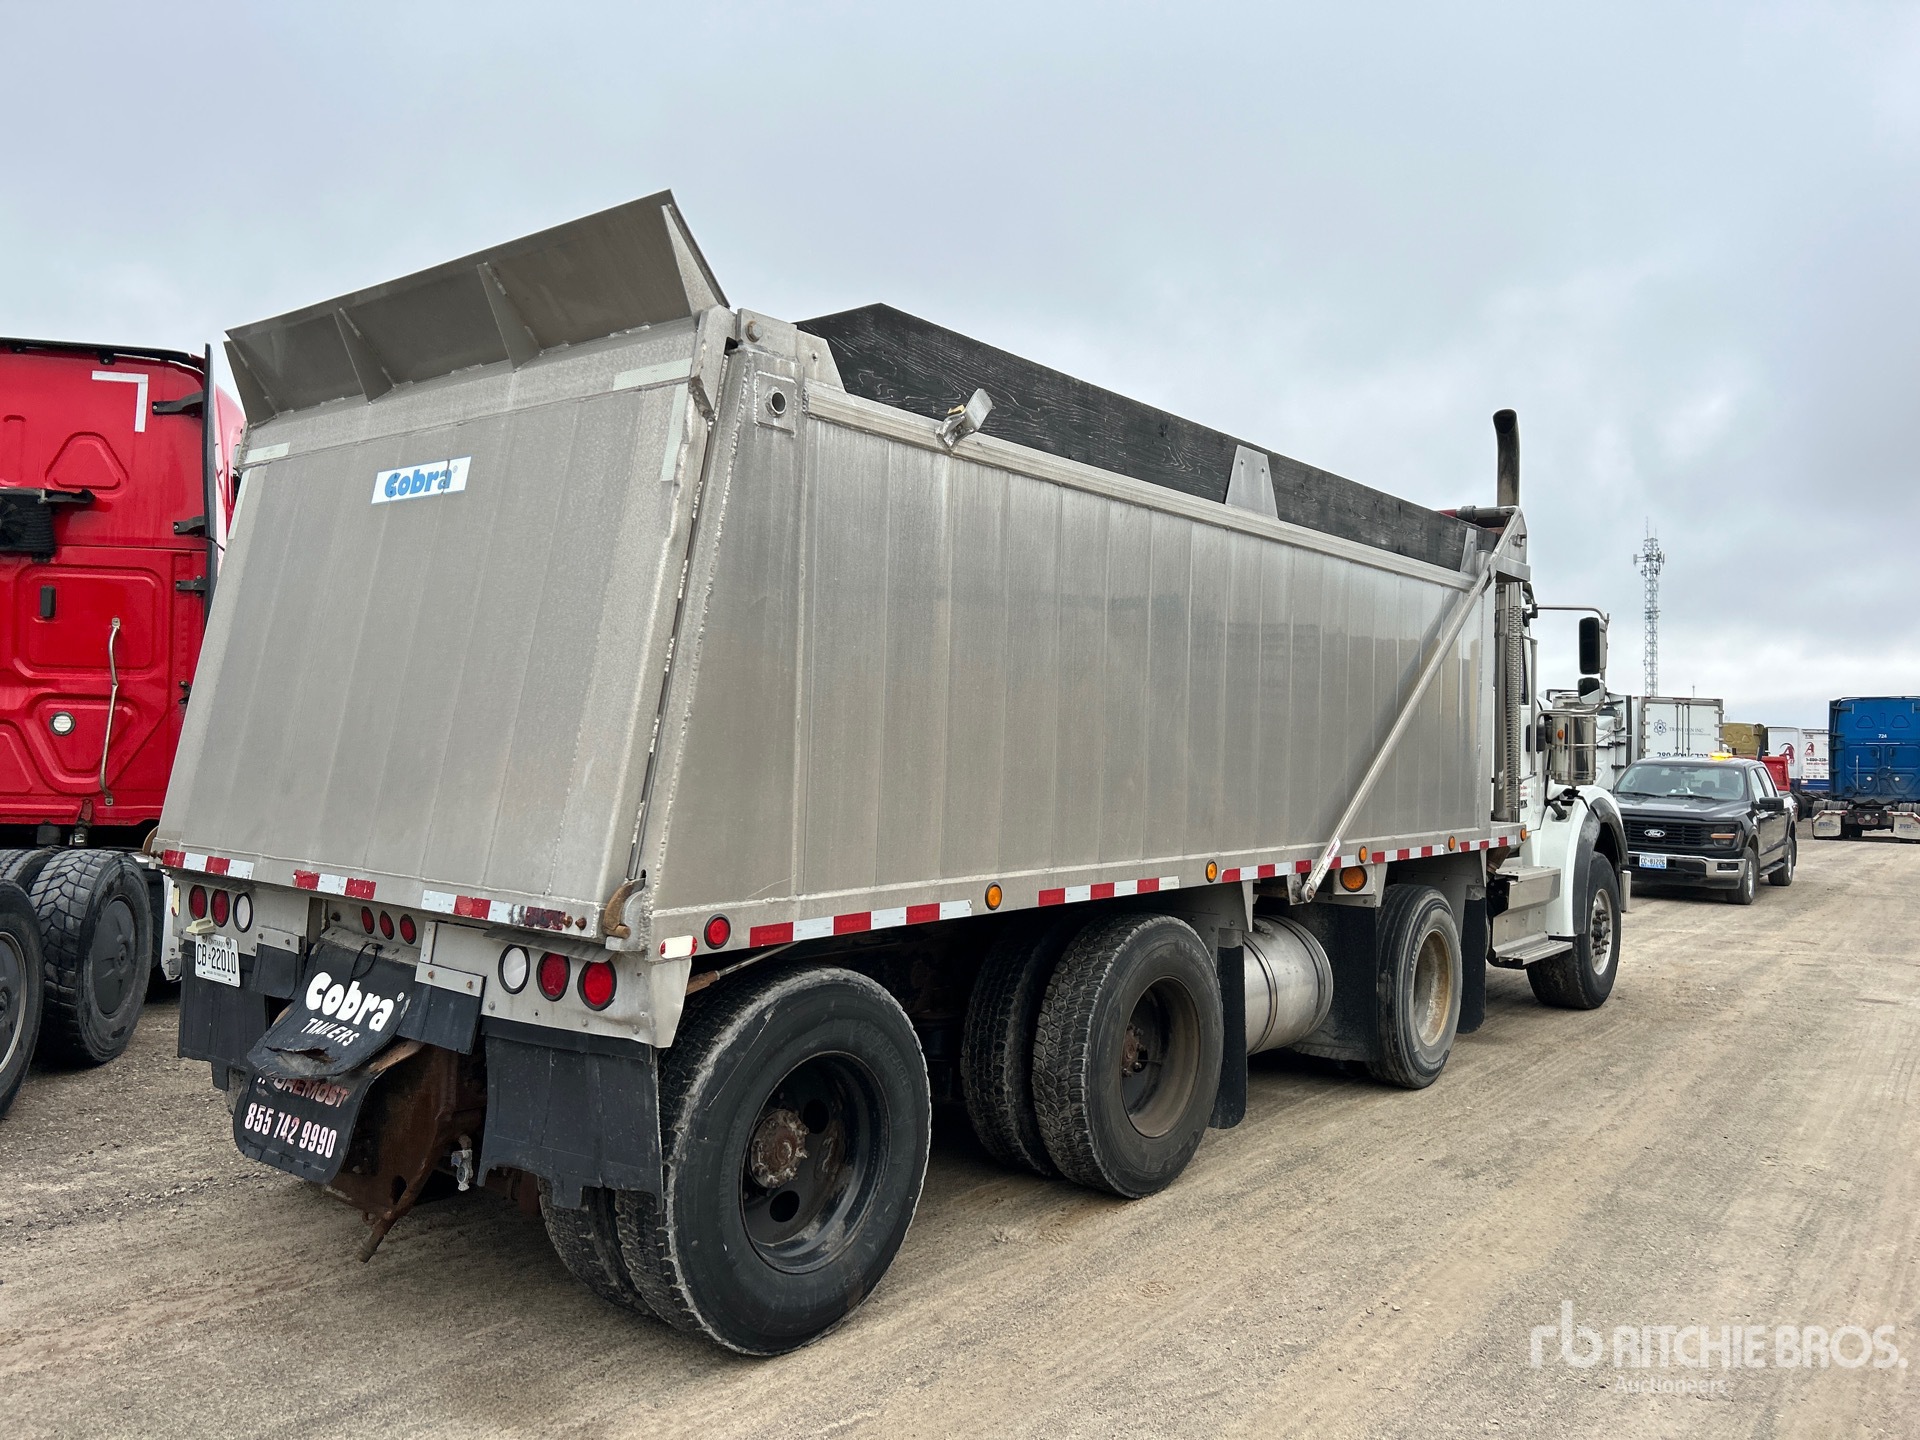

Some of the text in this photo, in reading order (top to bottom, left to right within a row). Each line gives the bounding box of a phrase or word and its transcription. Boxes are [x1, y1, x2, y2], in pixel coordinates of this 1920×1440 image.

[384, 469, 453, 498] Cobra
[301, 1018, 360, 1046] TRAILERS
[244, 1103, 337, 1159] 855 742 9990
